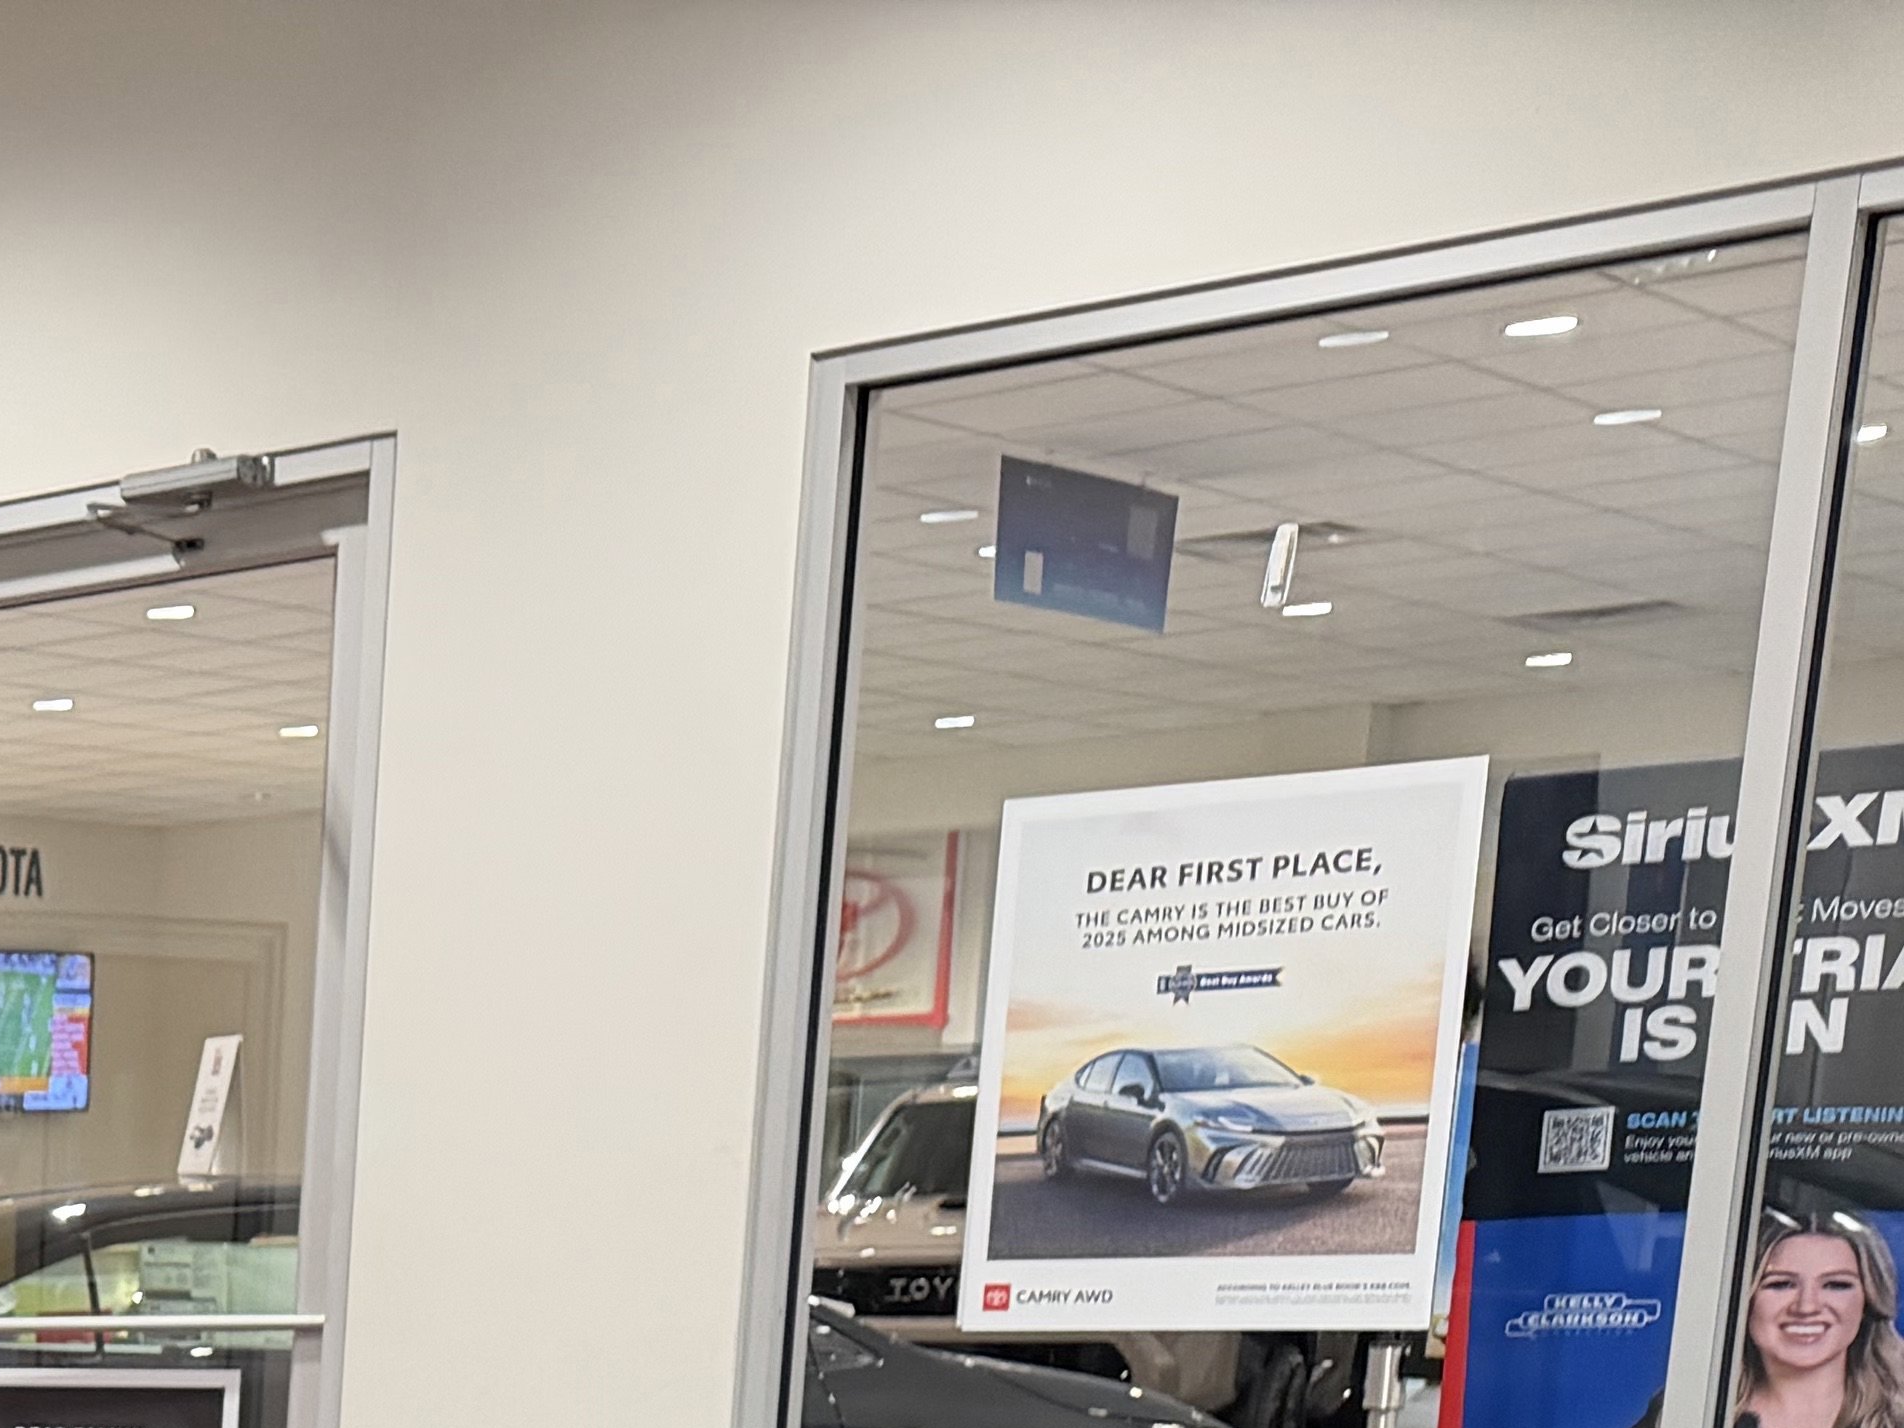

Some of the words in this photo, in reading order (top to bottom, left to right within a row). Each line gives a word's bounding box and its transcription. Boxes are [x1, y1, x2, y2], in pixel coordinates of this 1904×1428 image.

[1086, 865, 1168, 894] DEAR
[1178, 857, 1263, 886] FIRST
[1272, 847, 1383, 879] PLACE,
[1076, 911, 1110, 929] THE
[1117, 904, 1186, 925] CAMRY
[1192, 903, 1208, 919] IS
[1215, 899, 1252, 917] THE
[1259, 895, 1308, 914] BEST
[1313, 891, 1354, 910] BUY
[1360, 888, 1389, 906] OF
[1082, 931, 1127, 949] 2025
[1132, 925, 1210, 945] AMONG
[1217, 916, 1314, 939] MIDSIZED
[1320, 911, 1381, 932] CARS.
[1531, 915, 1582, 943] Get
[1589, 911, 1680, 939] Closer
[1689, 907, 1717, 931] to
[1498, 945, 1721, 1013] YOUR
[1619, 1004, 1697, 1063] IS
[1785, 997, 1849, 1056] N
[1627, 1111, 1687, 1129] SCAN
[1803, 1106, 1904, 1123] LISTENIN
[1836, 1130, 1904, 1147] pre-owne
[887, 1277, 958, 1303] TOY
[1016, 1288, 1072, 1306] CAMRY
[1076, 1288, 1114, 1305] AWD
[1554, 1294, 1617, 1309] KELLY
[1527, 1312, 1640, 1328] CLARKSON
